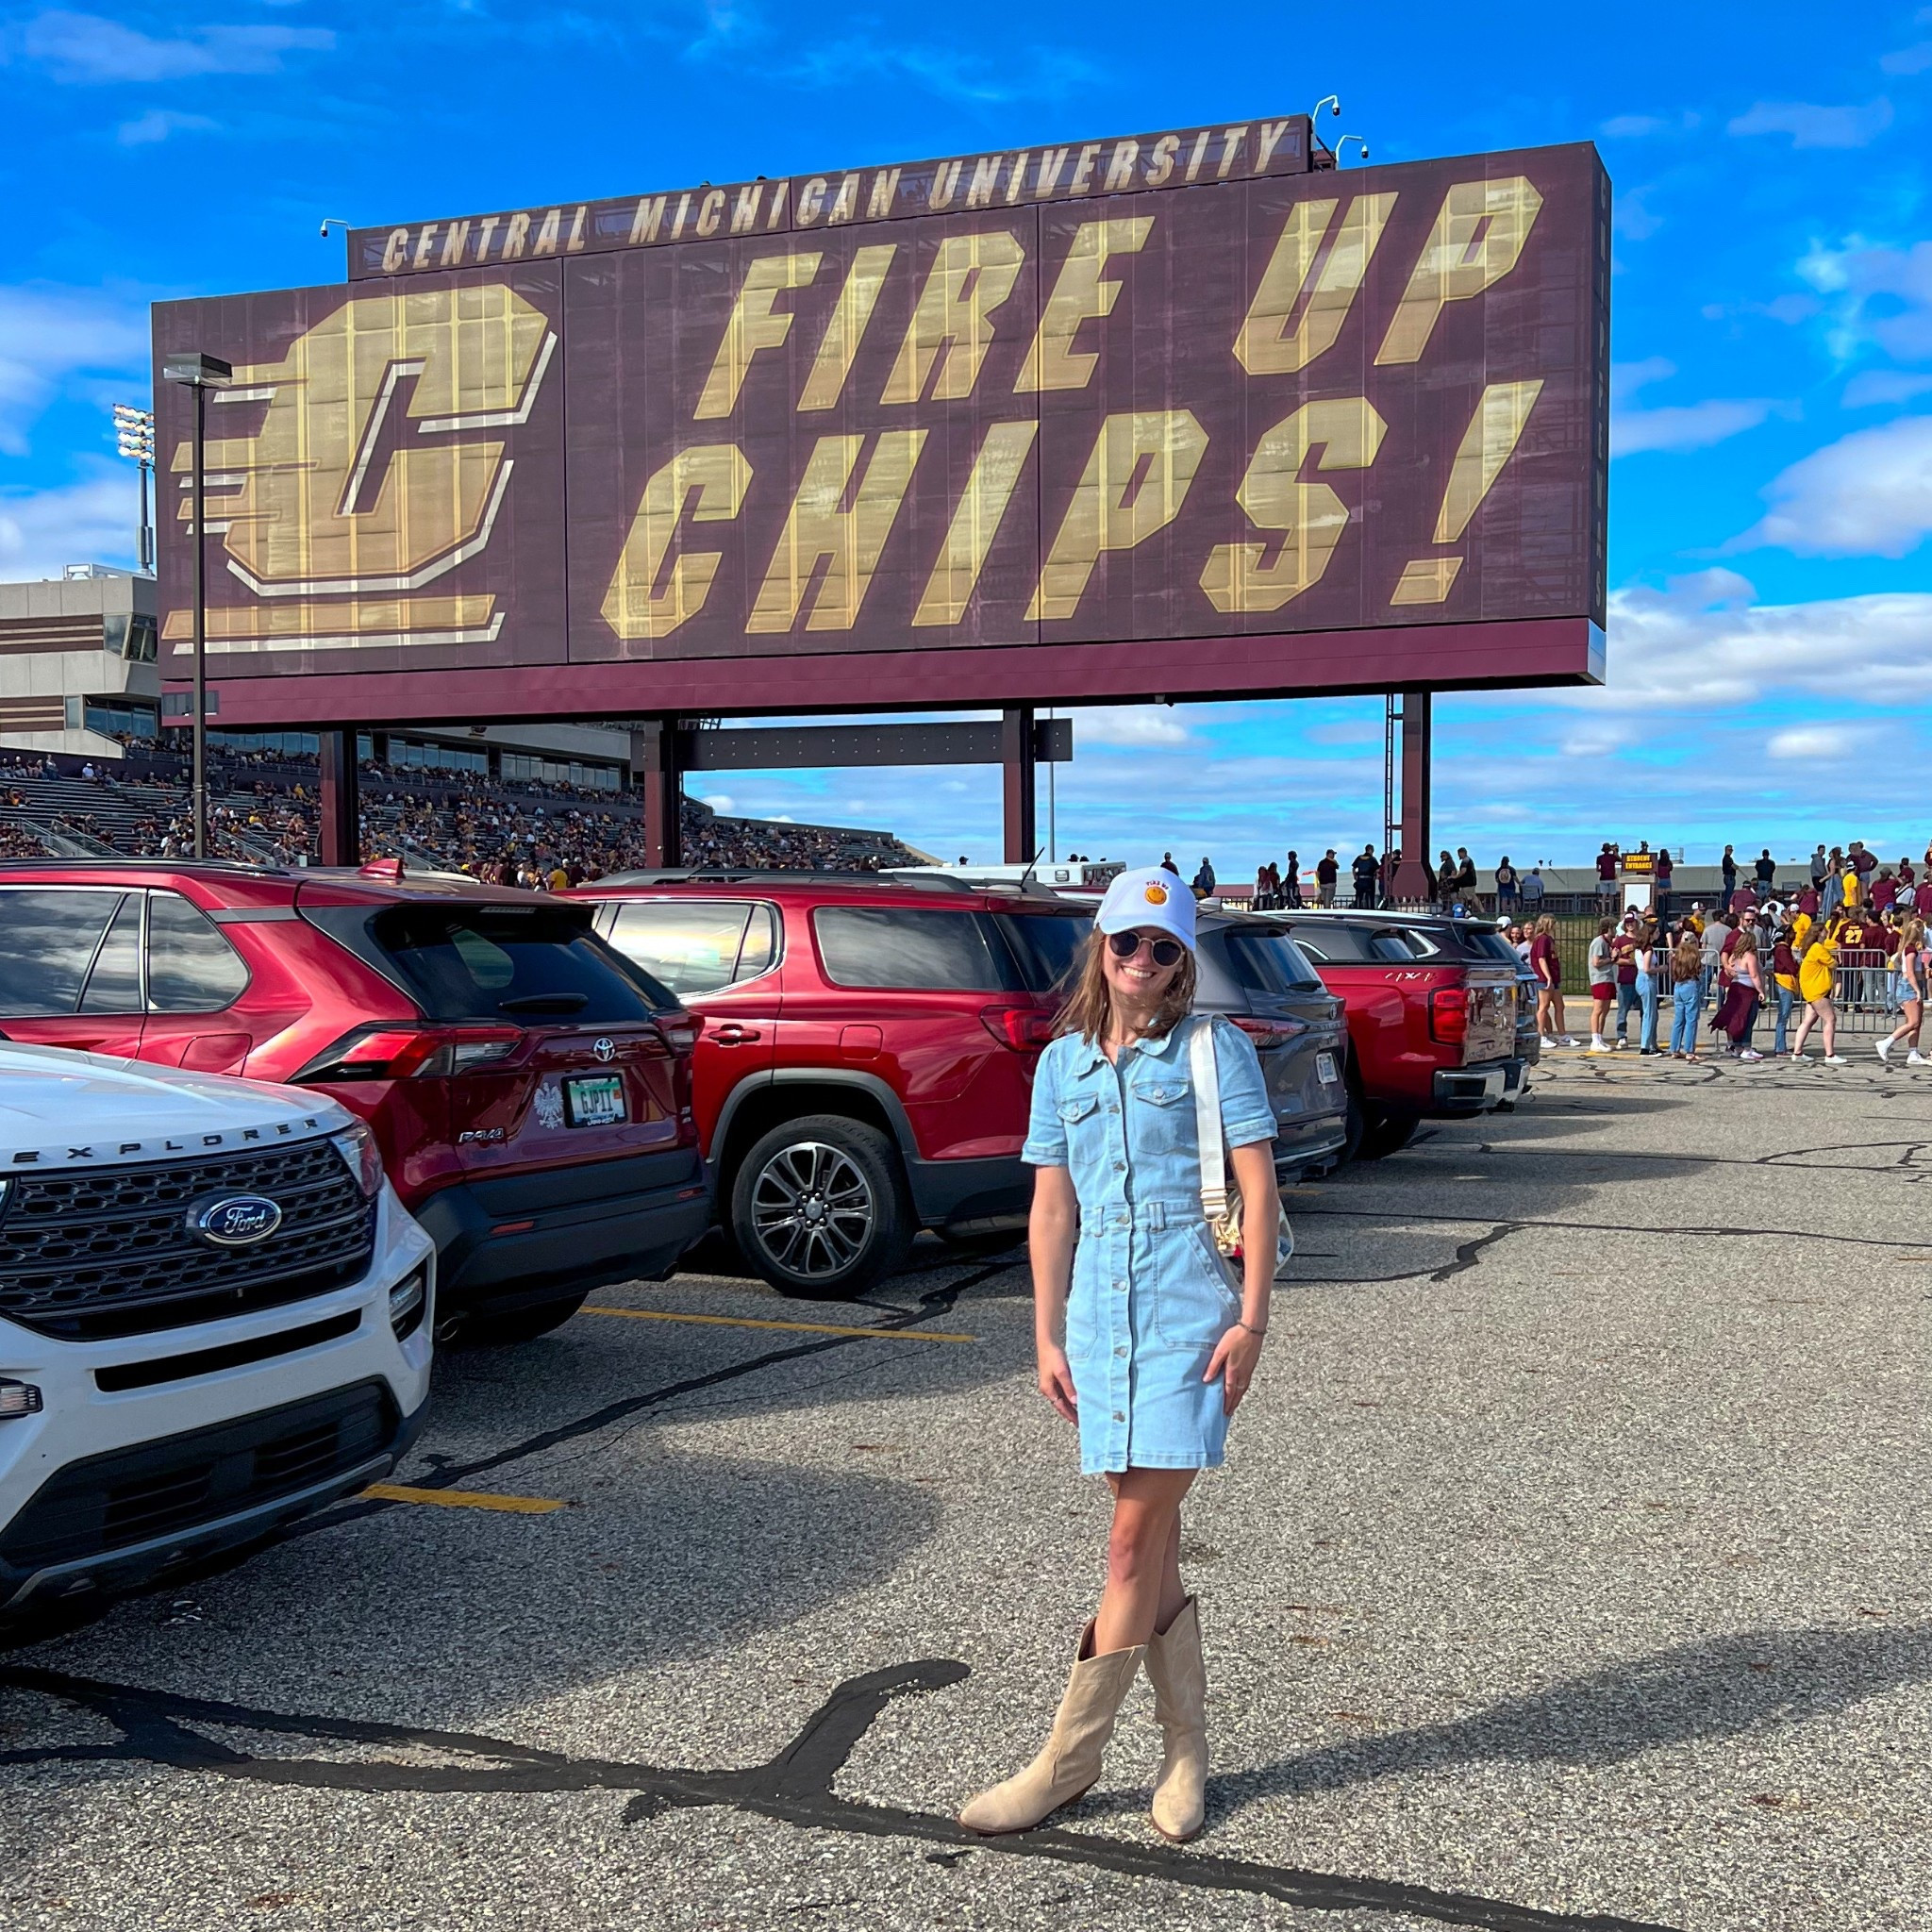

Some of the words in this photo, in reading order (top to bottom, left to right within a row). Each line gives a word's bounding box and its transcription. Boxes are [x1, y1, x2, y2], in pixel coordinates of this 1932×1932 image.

[381, 206, 587, 274] CENTRAL
[628, 168, 901, 244] MICHIGAN
[928, 121, 1289, 210] UNIVERSITY
[694, 215, 1156, 421] FIRE
[1232, 175, 1543, 375] UP
[600, 379, 1544, 641] CHIPS!
[1845, 929, 1863, 943] 27
[12, 1118, 319, 1163] EXPLORER
[458, 1127, 504, 1142] RAV4
[224, 1206, 267, 1235] Ford
